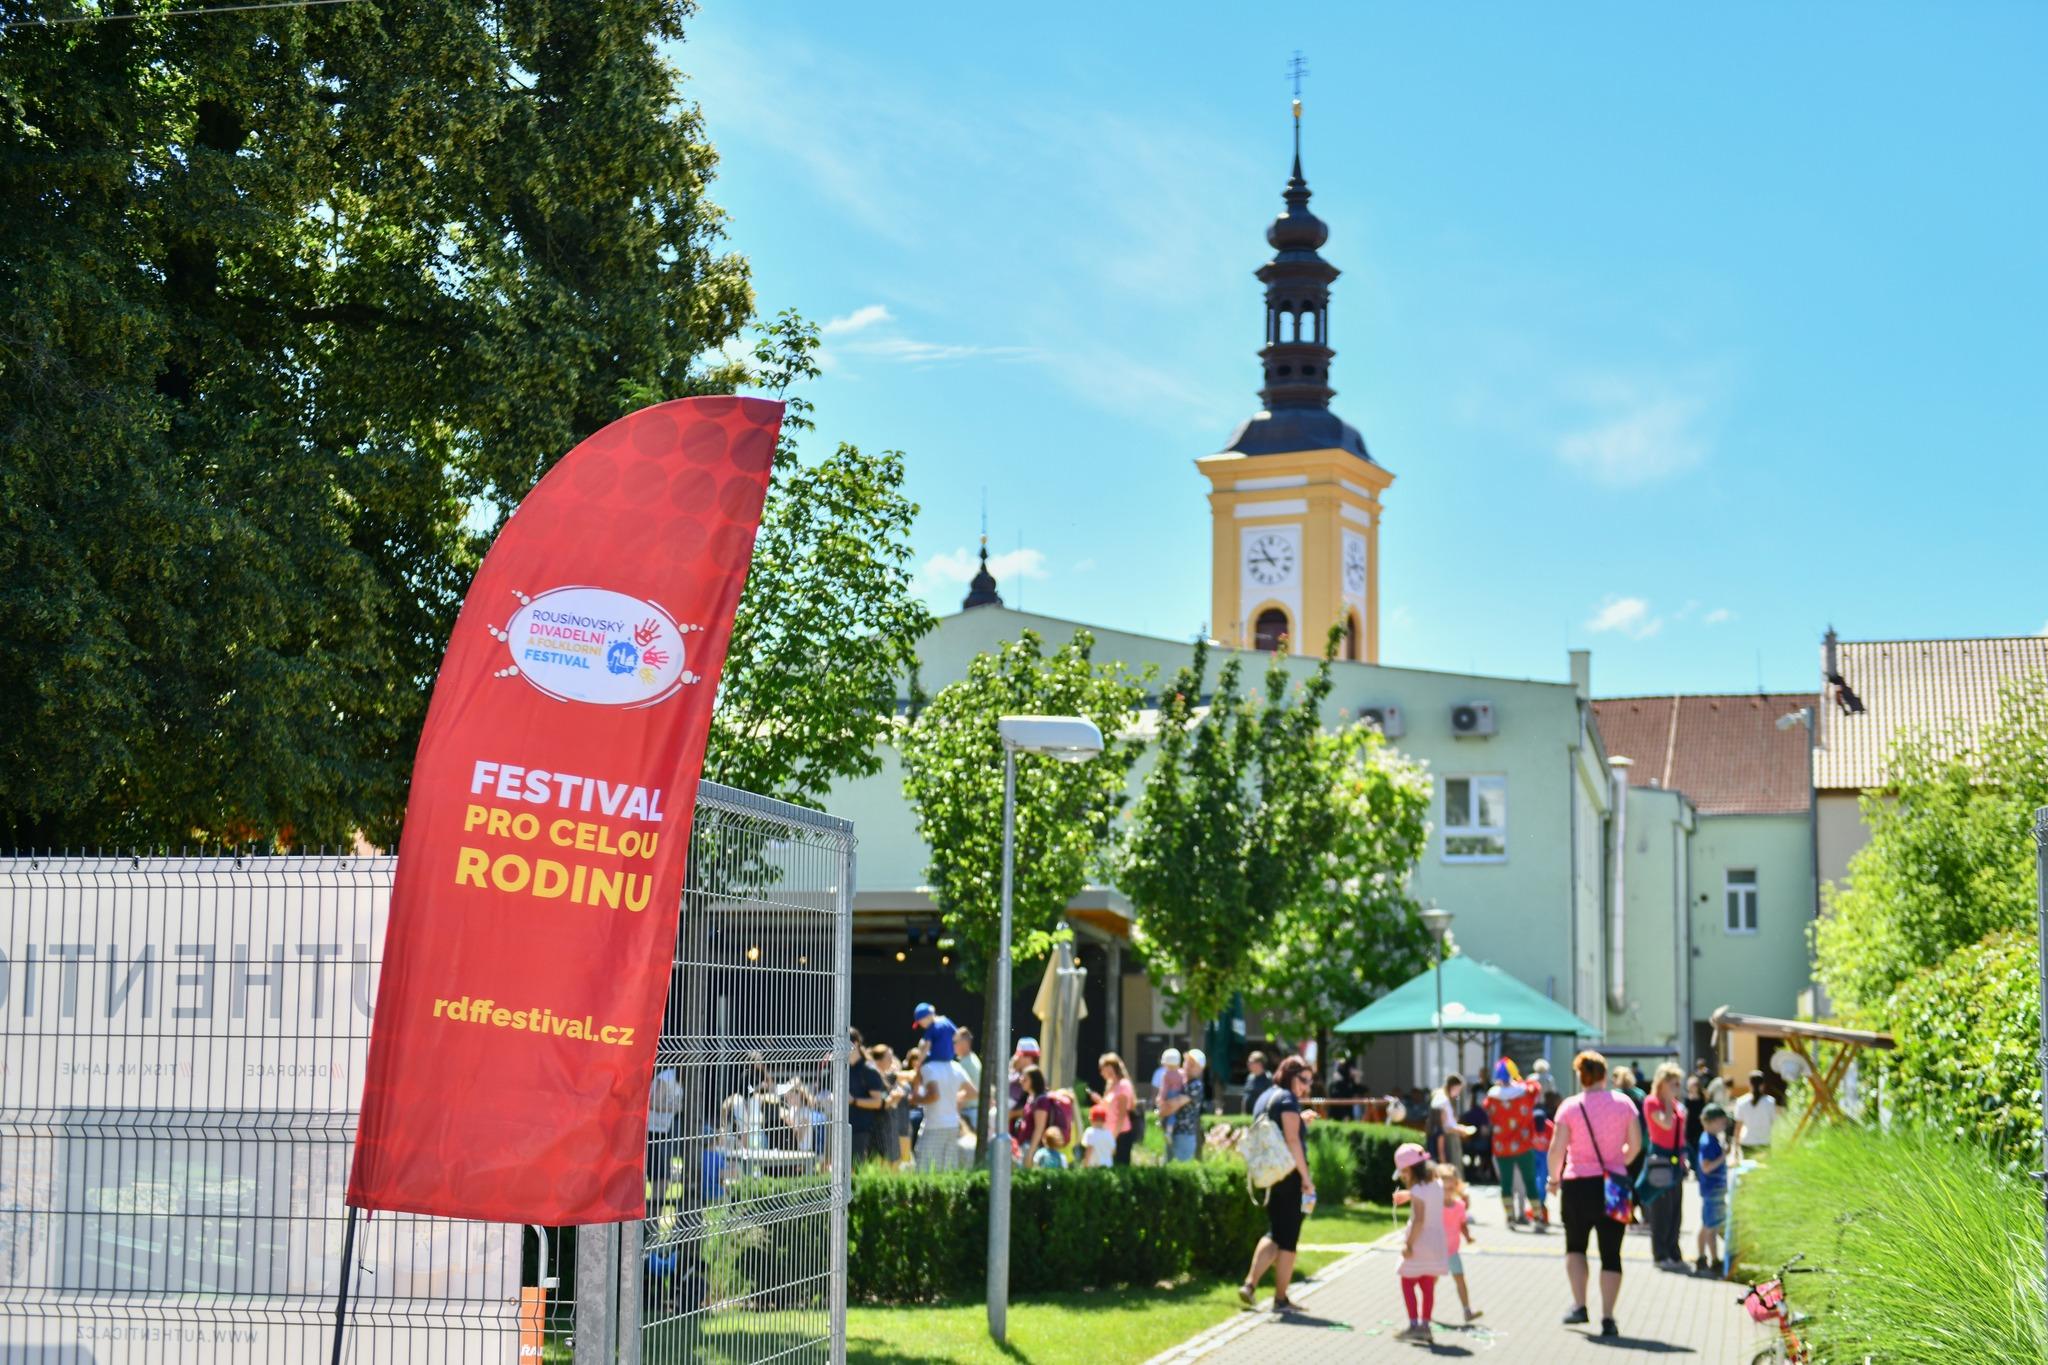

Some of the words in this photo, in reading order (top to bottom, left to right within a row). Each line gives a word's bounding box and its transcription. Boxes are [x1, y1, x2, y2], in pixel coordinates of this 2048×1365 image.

[530, 622, 606, 645] DIVADELNÍ
[532, 609, 625, 633] ROUSÍNOVSKÝ
[524, 648, 590, 669] FESTIVAL
[527, 639, 537, 647] A
[470, 760, 663, 822] FESTIVAL
[464, 804, 540, 841] PRO
[549, 818, 659, 860] CELOU
[455, 846, 653, 912] RODINU
[433, 996, 635, 1045] rdffestival.cz
